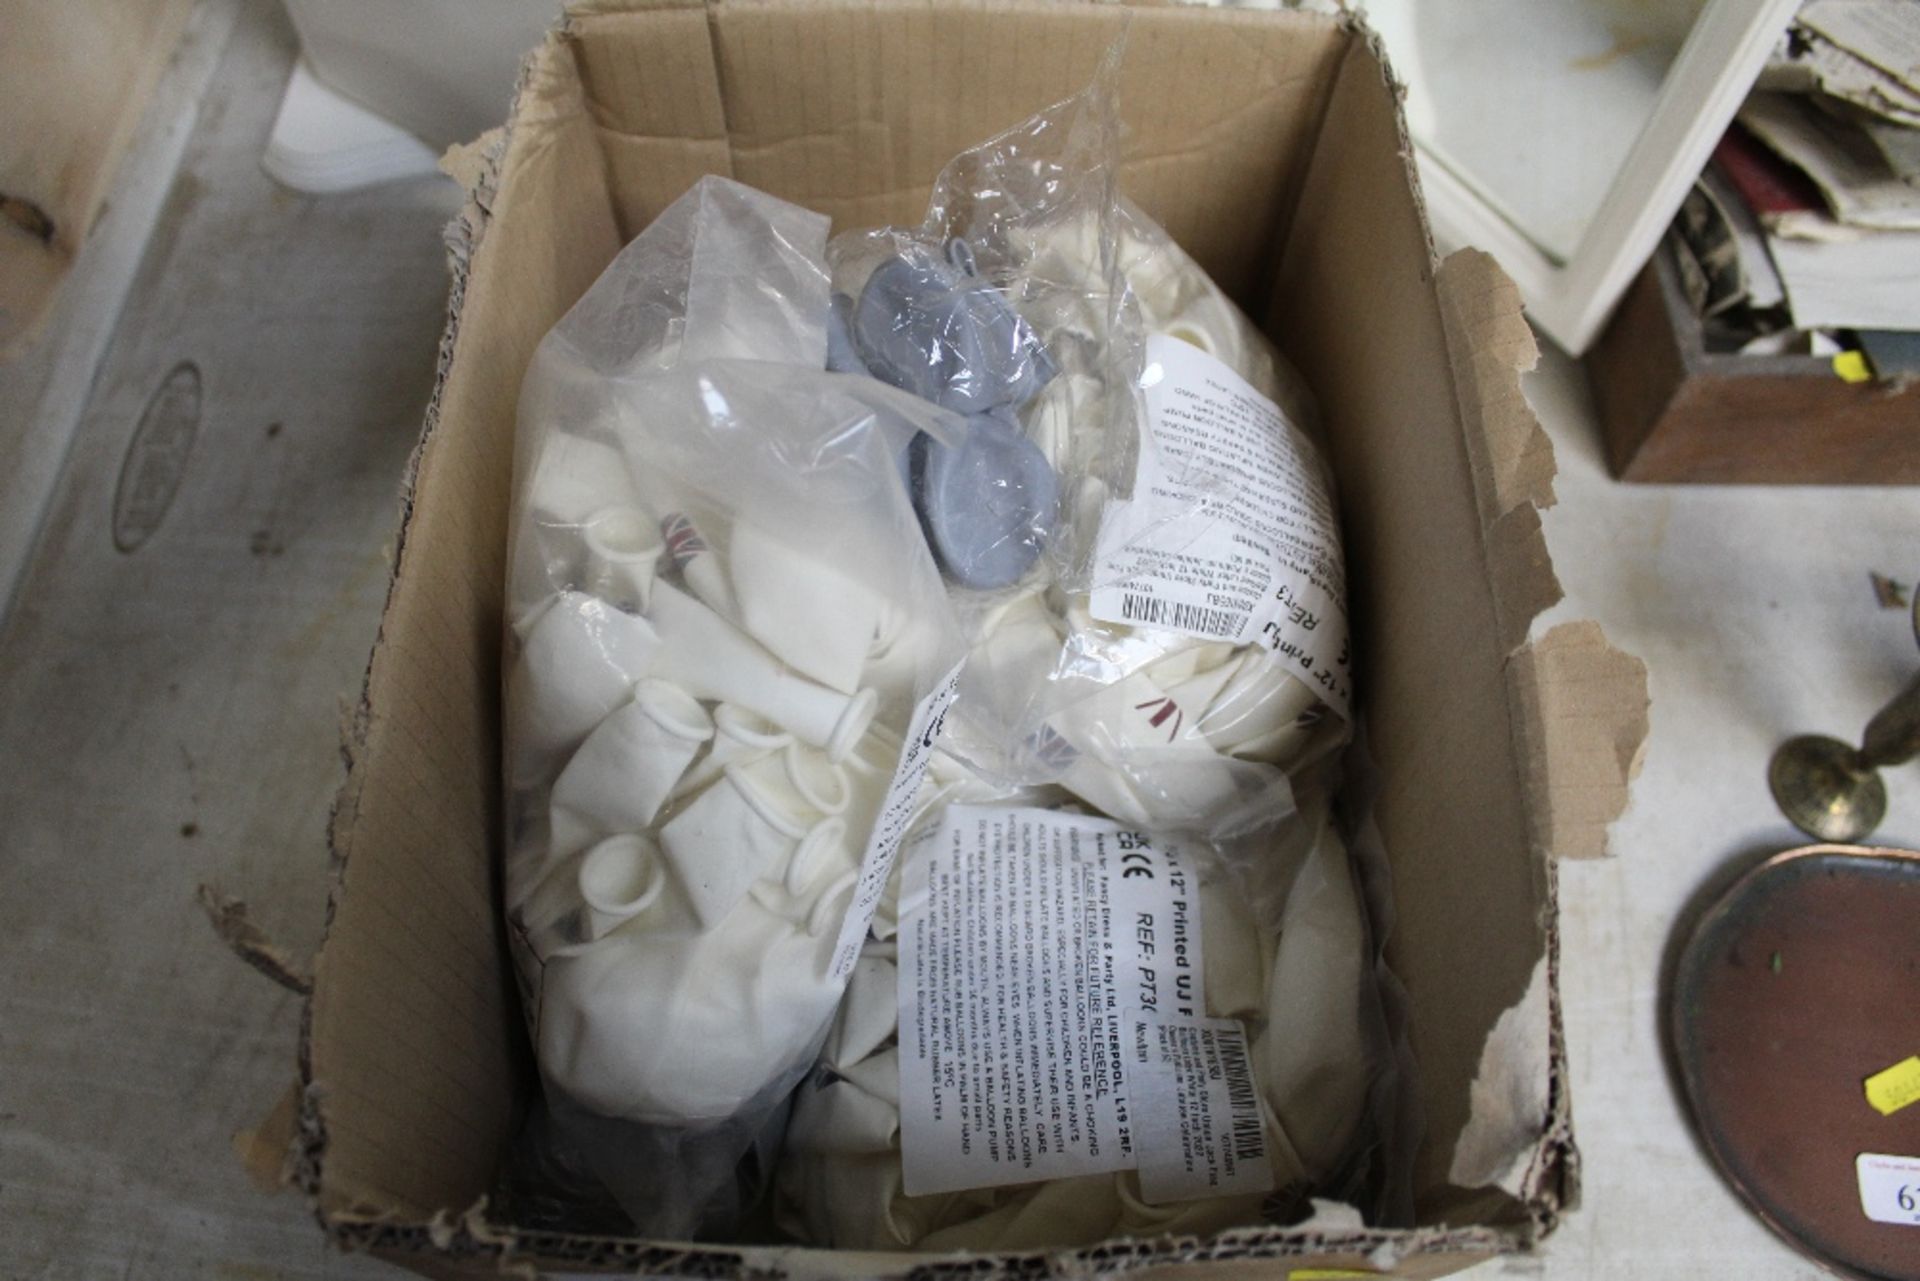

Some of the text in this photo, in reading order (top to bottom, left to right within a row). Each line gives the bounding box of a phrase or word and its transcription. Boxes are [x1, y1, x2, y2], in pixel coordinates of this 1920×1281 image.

[1088, 941, 1099, 964] FOR
[1134, 911, 1155, 962] REF:
[1170, 900, 1190, 967] Printed
[1089, 966, 1102, 1015] FUTURE
[1102, 955, 1115, 984] Party
[1176, 974, 1190, 1000] UJ
[1058, 988, 1068, 1009] FOR
[1075, 978, 1086, 1032] BALLOONS
[997, 1007, 1007, 1049] HEALTH
[1060, 1012, 1072, 1064] CHILDREN
[1078, 1034, 1089, 1071] COULD
[1092, 1017, 1108, 1096] REFERENCE
[1107, 1015, 1124, 1093] LIVERPOOL,
[984, 1076, 996, 1127] BALLOON
[1050, 1098, 1060, 1119] USE
[1115, 1097, 1127, 1121] L19
[1084, 1103, 1098, 1156] CHOKING
[1118, 1127, 1131, 1157] 2RF.
